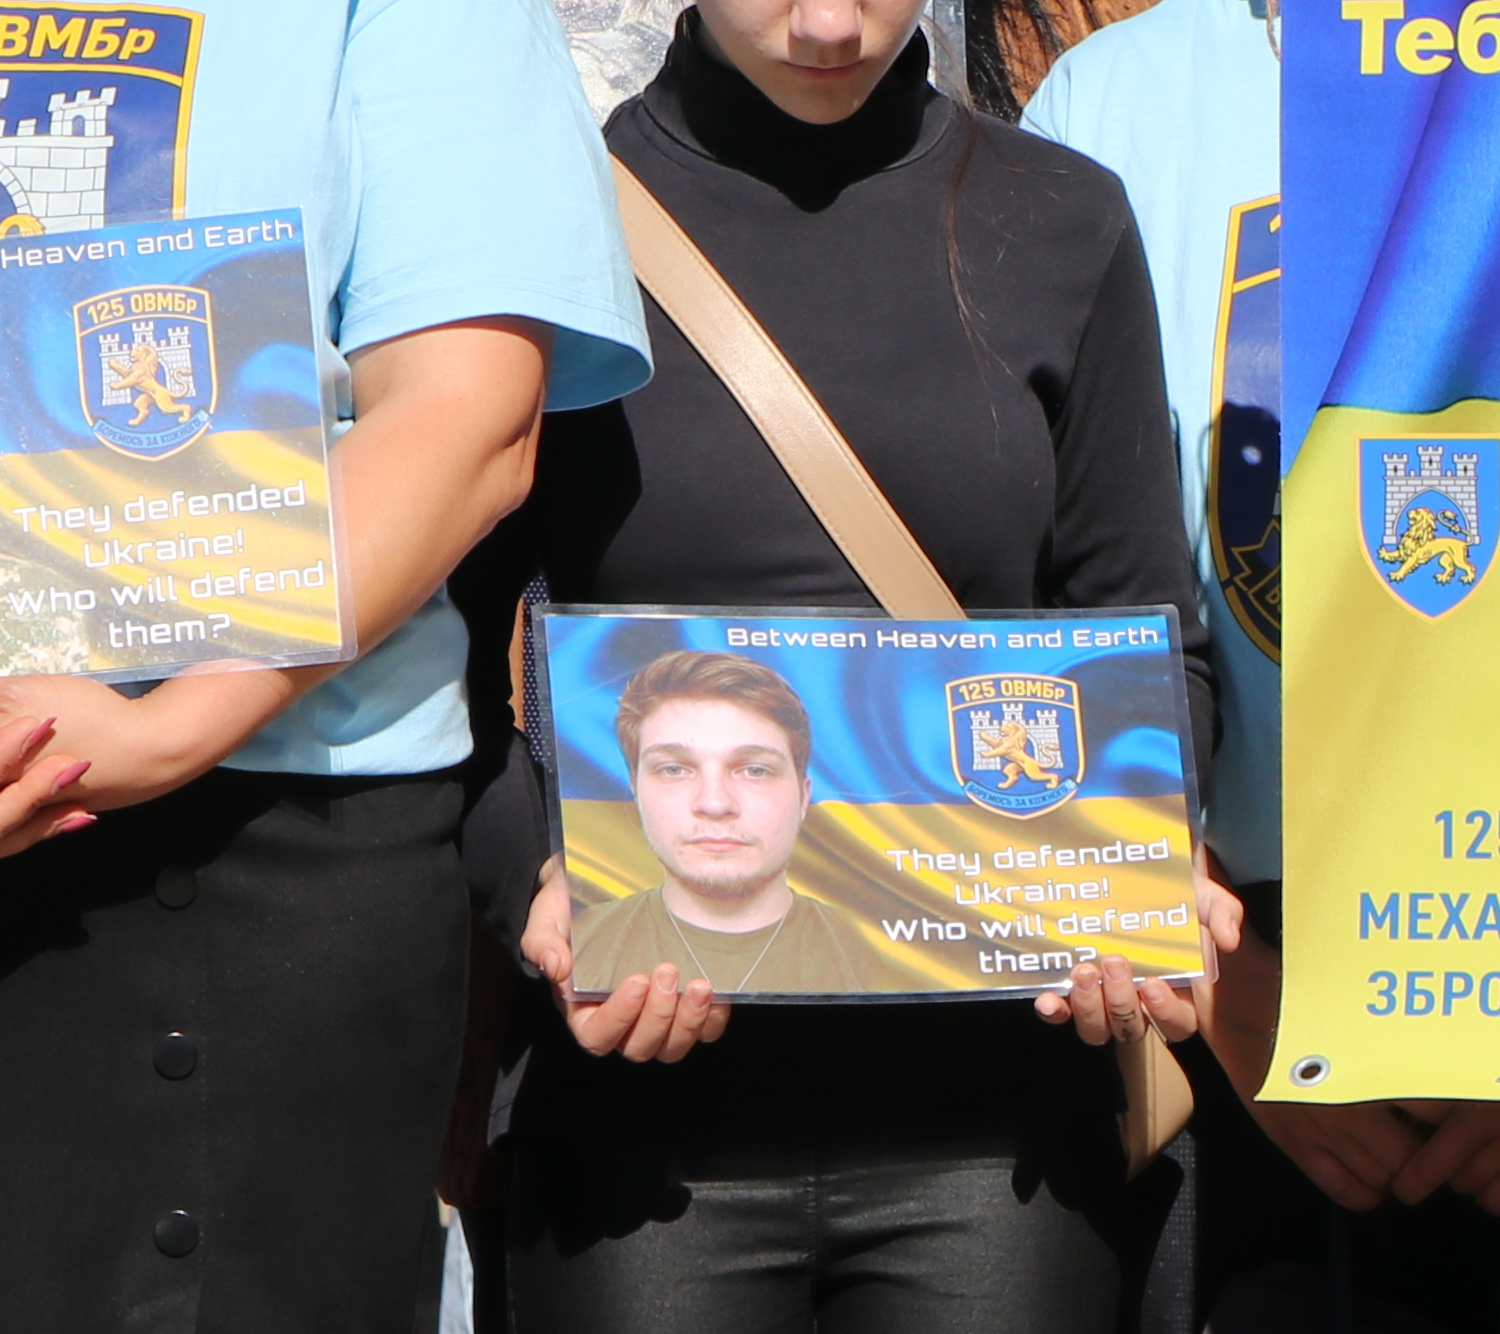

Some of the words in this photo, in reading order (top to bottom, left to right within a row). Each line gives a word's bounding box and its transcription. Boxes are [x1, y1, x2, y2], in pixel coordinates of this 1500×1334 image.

[0, 238, 130, 270] Heaven
[136, 225, 193, 257] and
[205, 217, 295, 249] Earth
[87, 297, 125, 324] 125
[130, 292, 197, 314] ОВМБр
[13, 500, 113, 535] They
[124, 479, 306, 523] defended
[83, 529, 246, 568] Ukraine!
[6, 583, 97, 616] Who
[108, 571, 178, 605] will
[189, 561, 326, 600] defend
[108, 611, 231, 651] them?
[726, 627, 867, 650] Between
[877, 628, 996, 650] Heaven
[1006, 626, 1063, 649] and
[1072, 625, 1159, 648] Earth
[959, 681, 996, 701] 125
[1000, 680, 1066, 700] ОВМБр
[887, 848, 982, 878] They
[993, 838, 1171, 873] defended
[954, 874, 1111, 906] Ukraine!
[881, 915, 966, 942] Who
[979, 910, 1047, 939] will
[1057, 904, 1189, 934] defend
[979, 945, 1097, 974] them?
